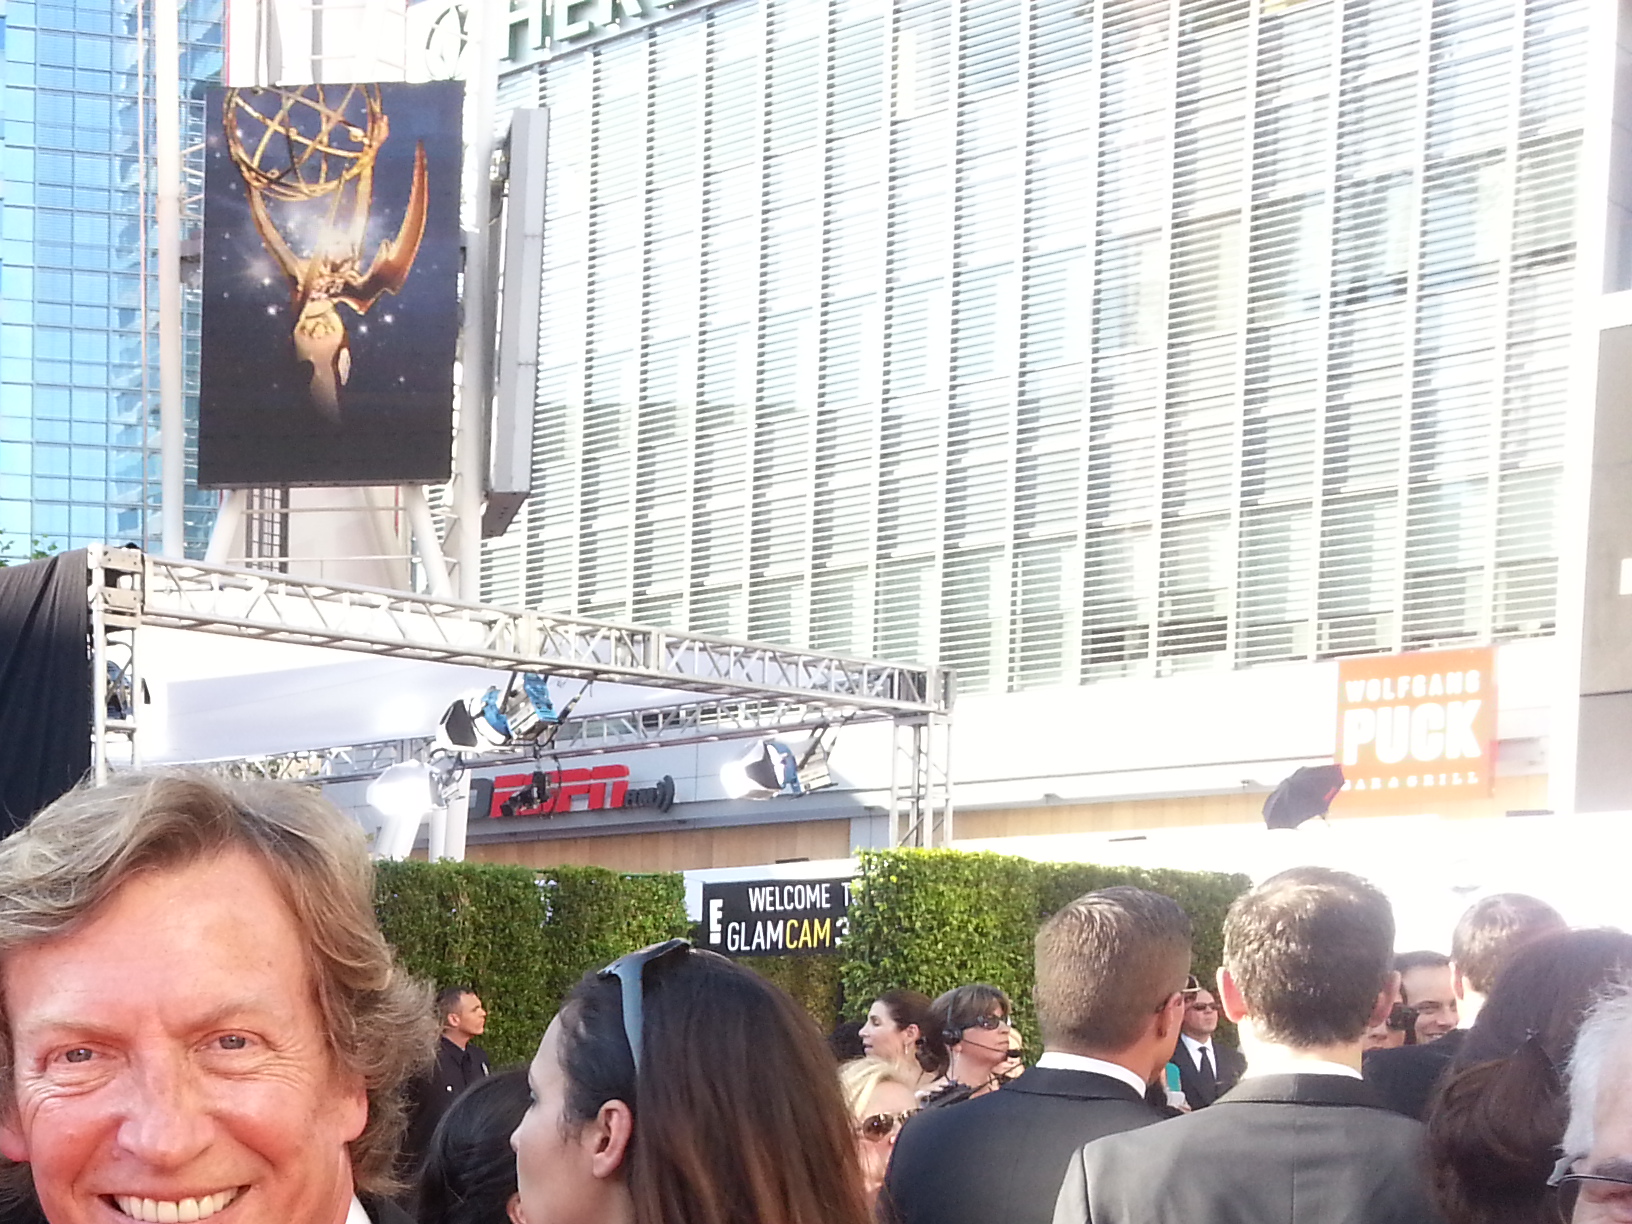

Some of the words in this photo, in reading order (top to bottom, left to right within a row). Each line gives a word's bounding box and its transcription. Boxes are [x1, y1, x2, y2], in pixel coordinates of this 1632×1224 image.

[1345, 670, 1481, 703] WOLFGANG
[1342, 699, 1483, 766] PUCK
[1406, 771, 1479, 787] GRILL
[748, 883, 831, 912] WELCOME
[727, 918, 831, 951] GLAMCAM
